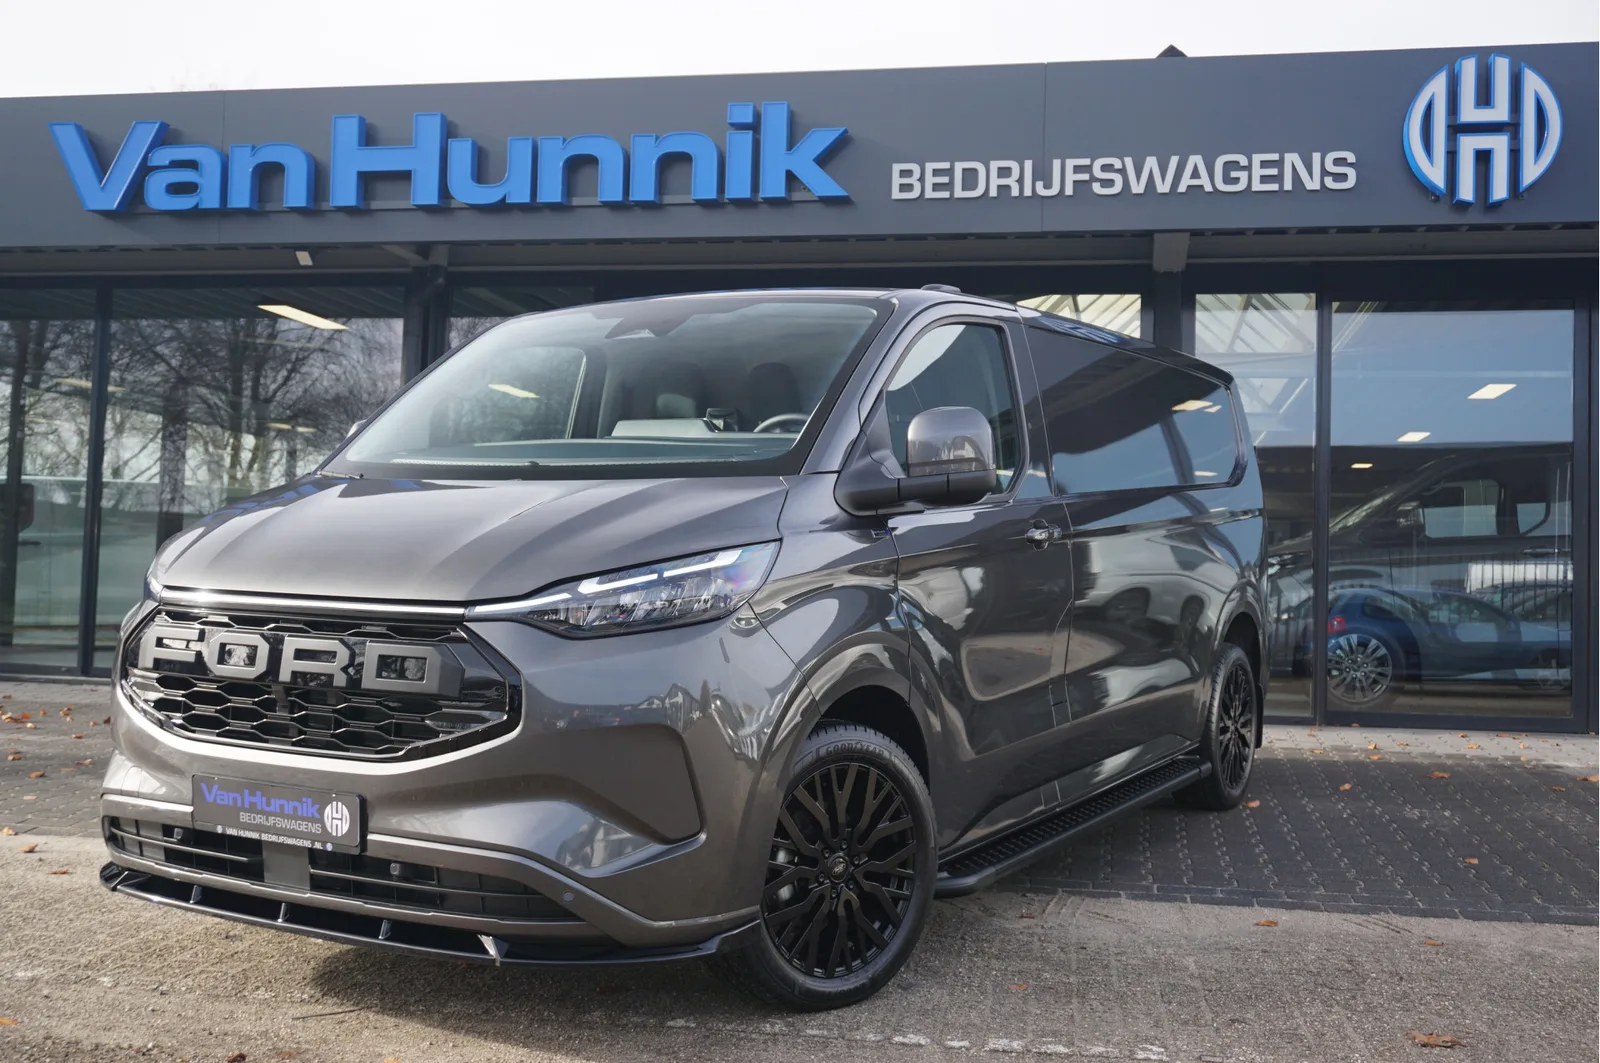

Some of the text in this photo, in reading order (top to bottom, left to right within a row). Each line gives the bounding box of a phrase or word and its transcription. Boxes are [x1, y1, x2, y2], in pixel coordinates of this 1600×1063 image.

[890, 151, 1357, 200] BEDRIJFSWAGENS
[139, 624, 464, 697] FORD
[225, 827, 238, 837] VAN
[238, 829, 260, 840] HUNNIK
[261, 834, 312, 848] BEDRIJFSWAGENS
[239, 812, 322, 834] BEDRIJFSWAGENS
